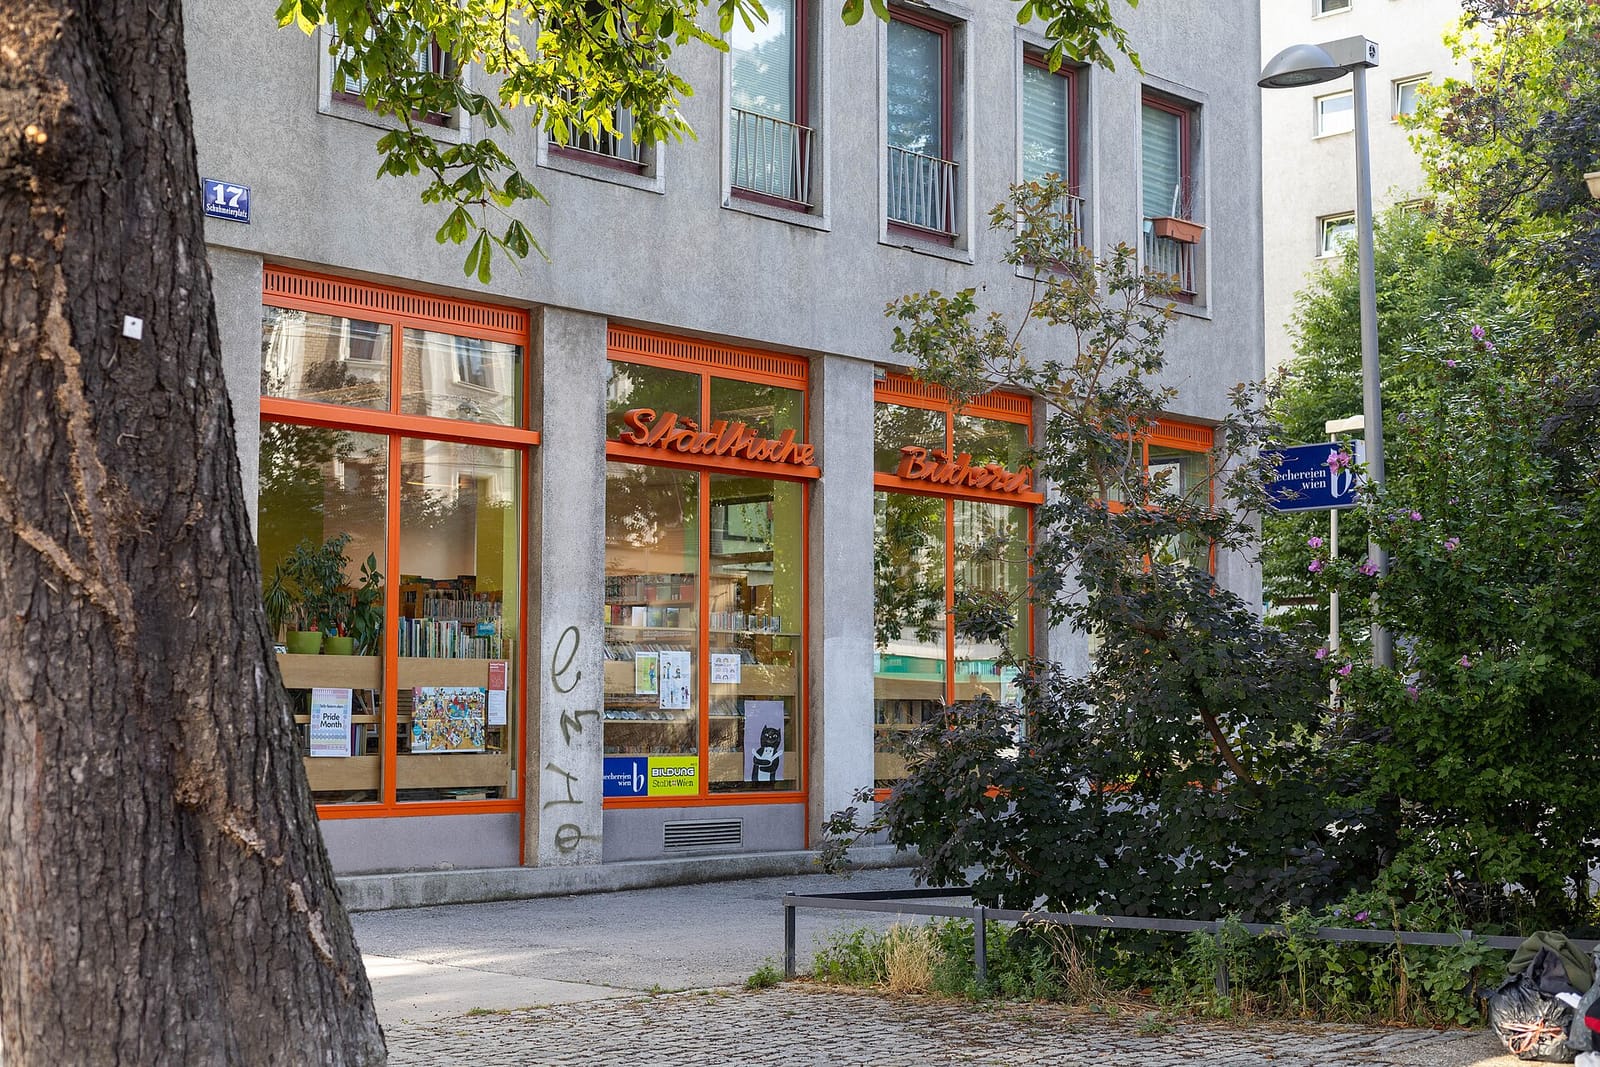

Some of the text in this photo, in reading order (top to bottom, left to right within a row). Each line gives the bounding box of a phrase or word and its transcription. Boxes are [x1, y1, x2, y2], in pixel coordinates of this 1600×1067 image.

[212, 184, 243, 207] 17
[1302, 479, 1326, 490] wien
[322, 712, 340, 721] Pride
[651, 767, 695, 777] BILDUNG
